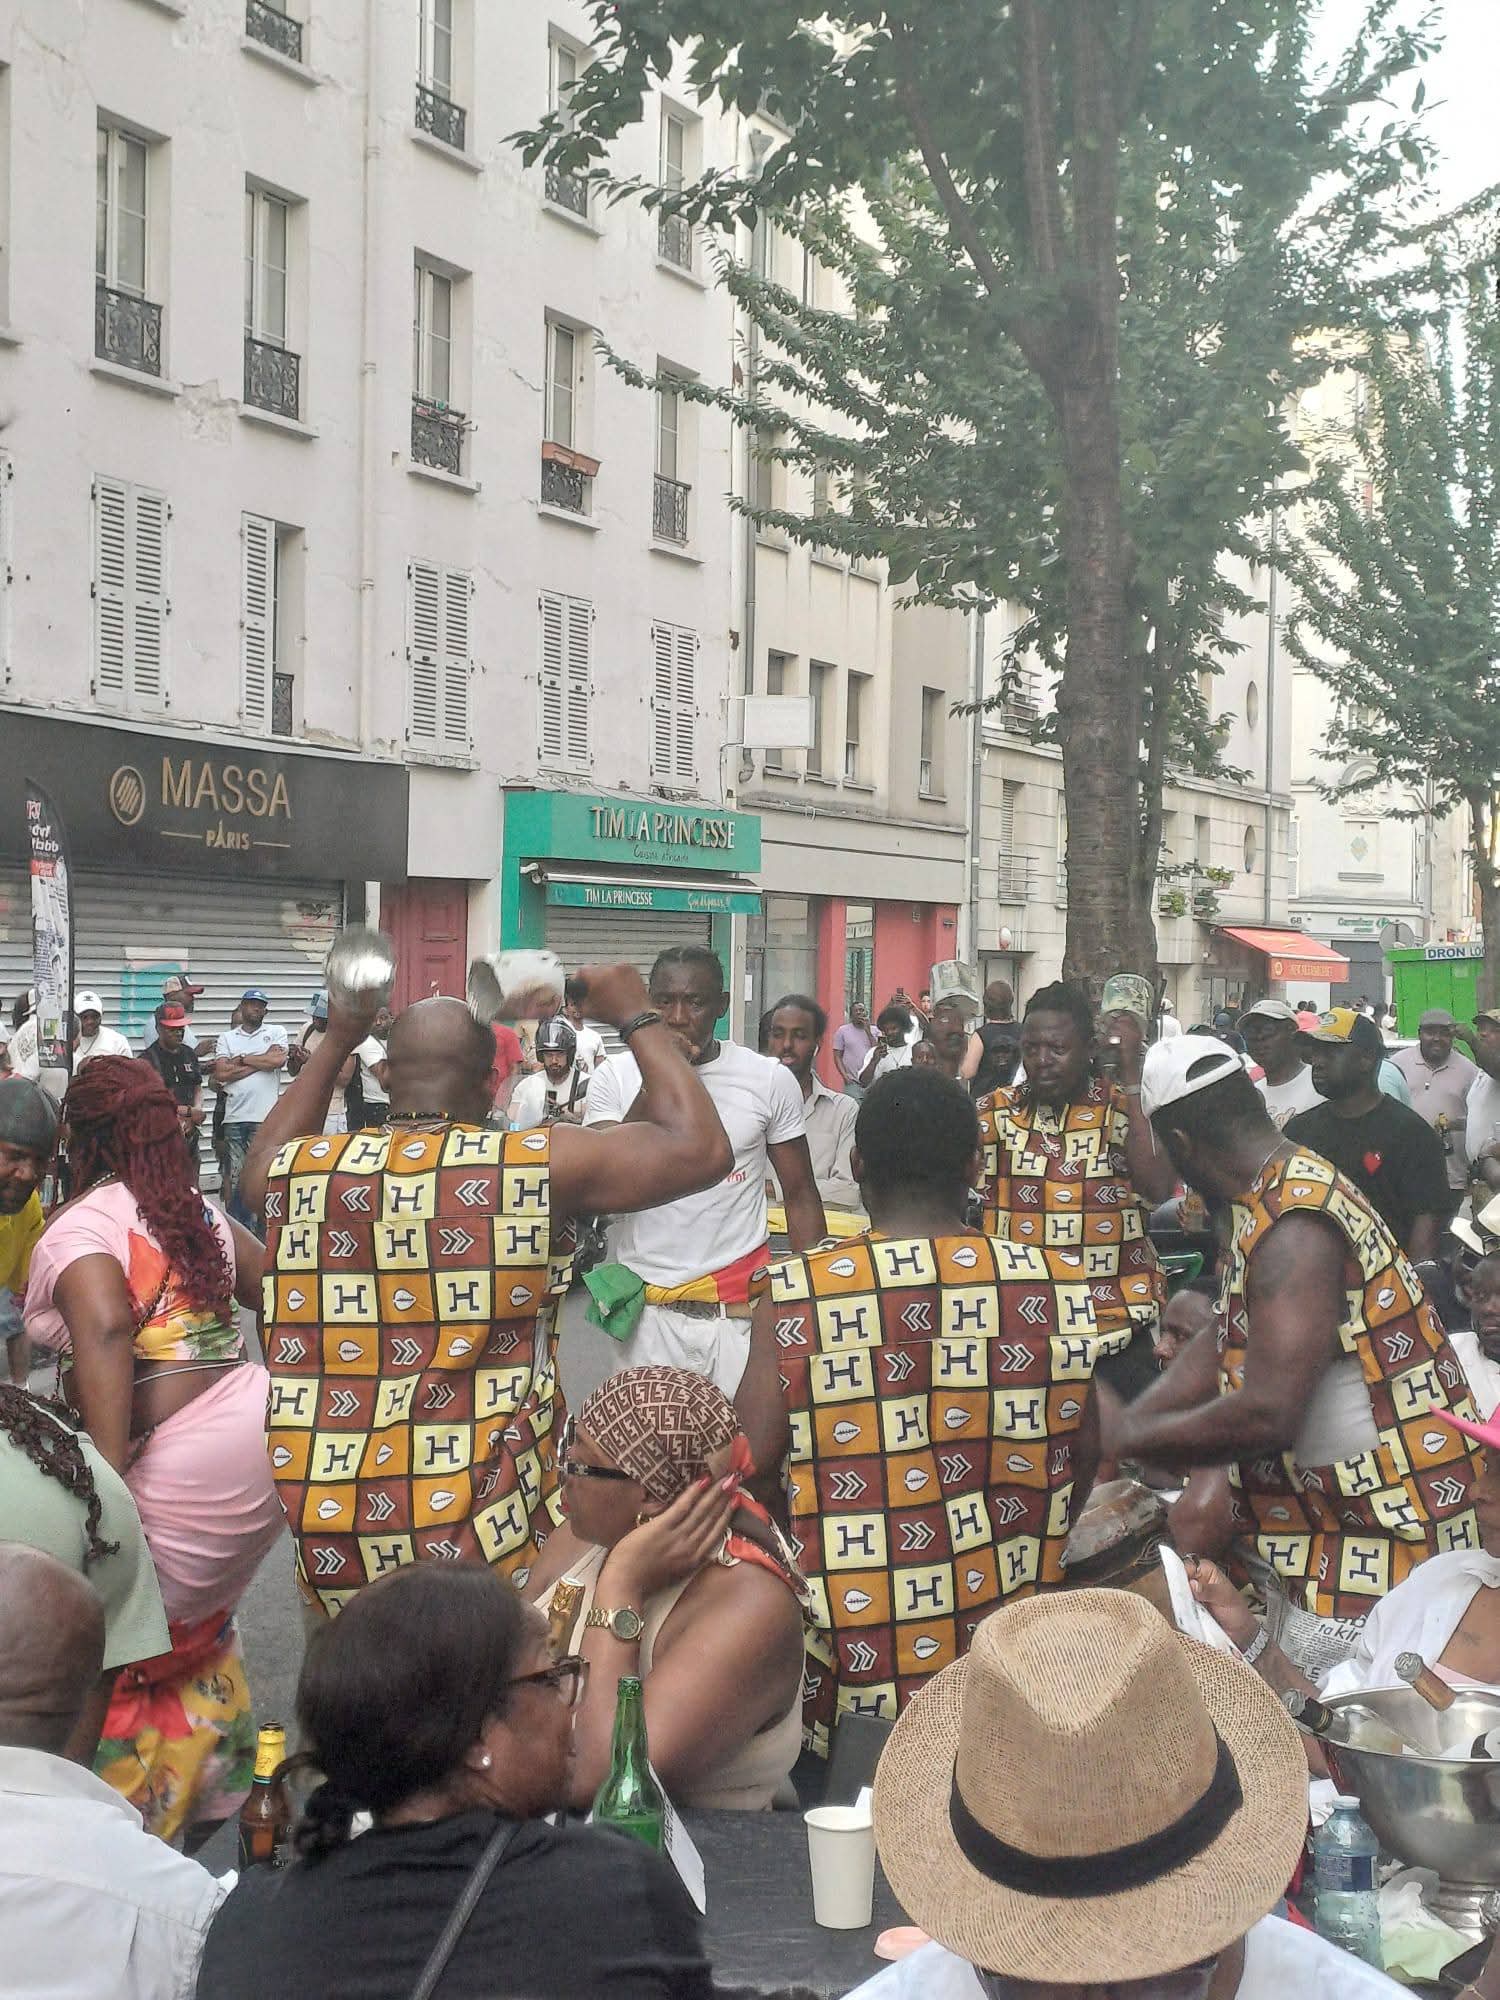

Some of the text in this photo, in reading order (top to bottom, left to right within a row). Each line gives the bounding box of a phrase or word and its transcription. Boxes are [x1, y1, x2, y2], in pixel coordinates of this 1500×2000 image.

[162, 756, 291, 818] MASSA
[206, 820, 249, 850] PARIS
[589, 806, 735, 849] TIM LA PRINCESSE
[585, 888, 653, 905] TIM LA PRINCESSE
